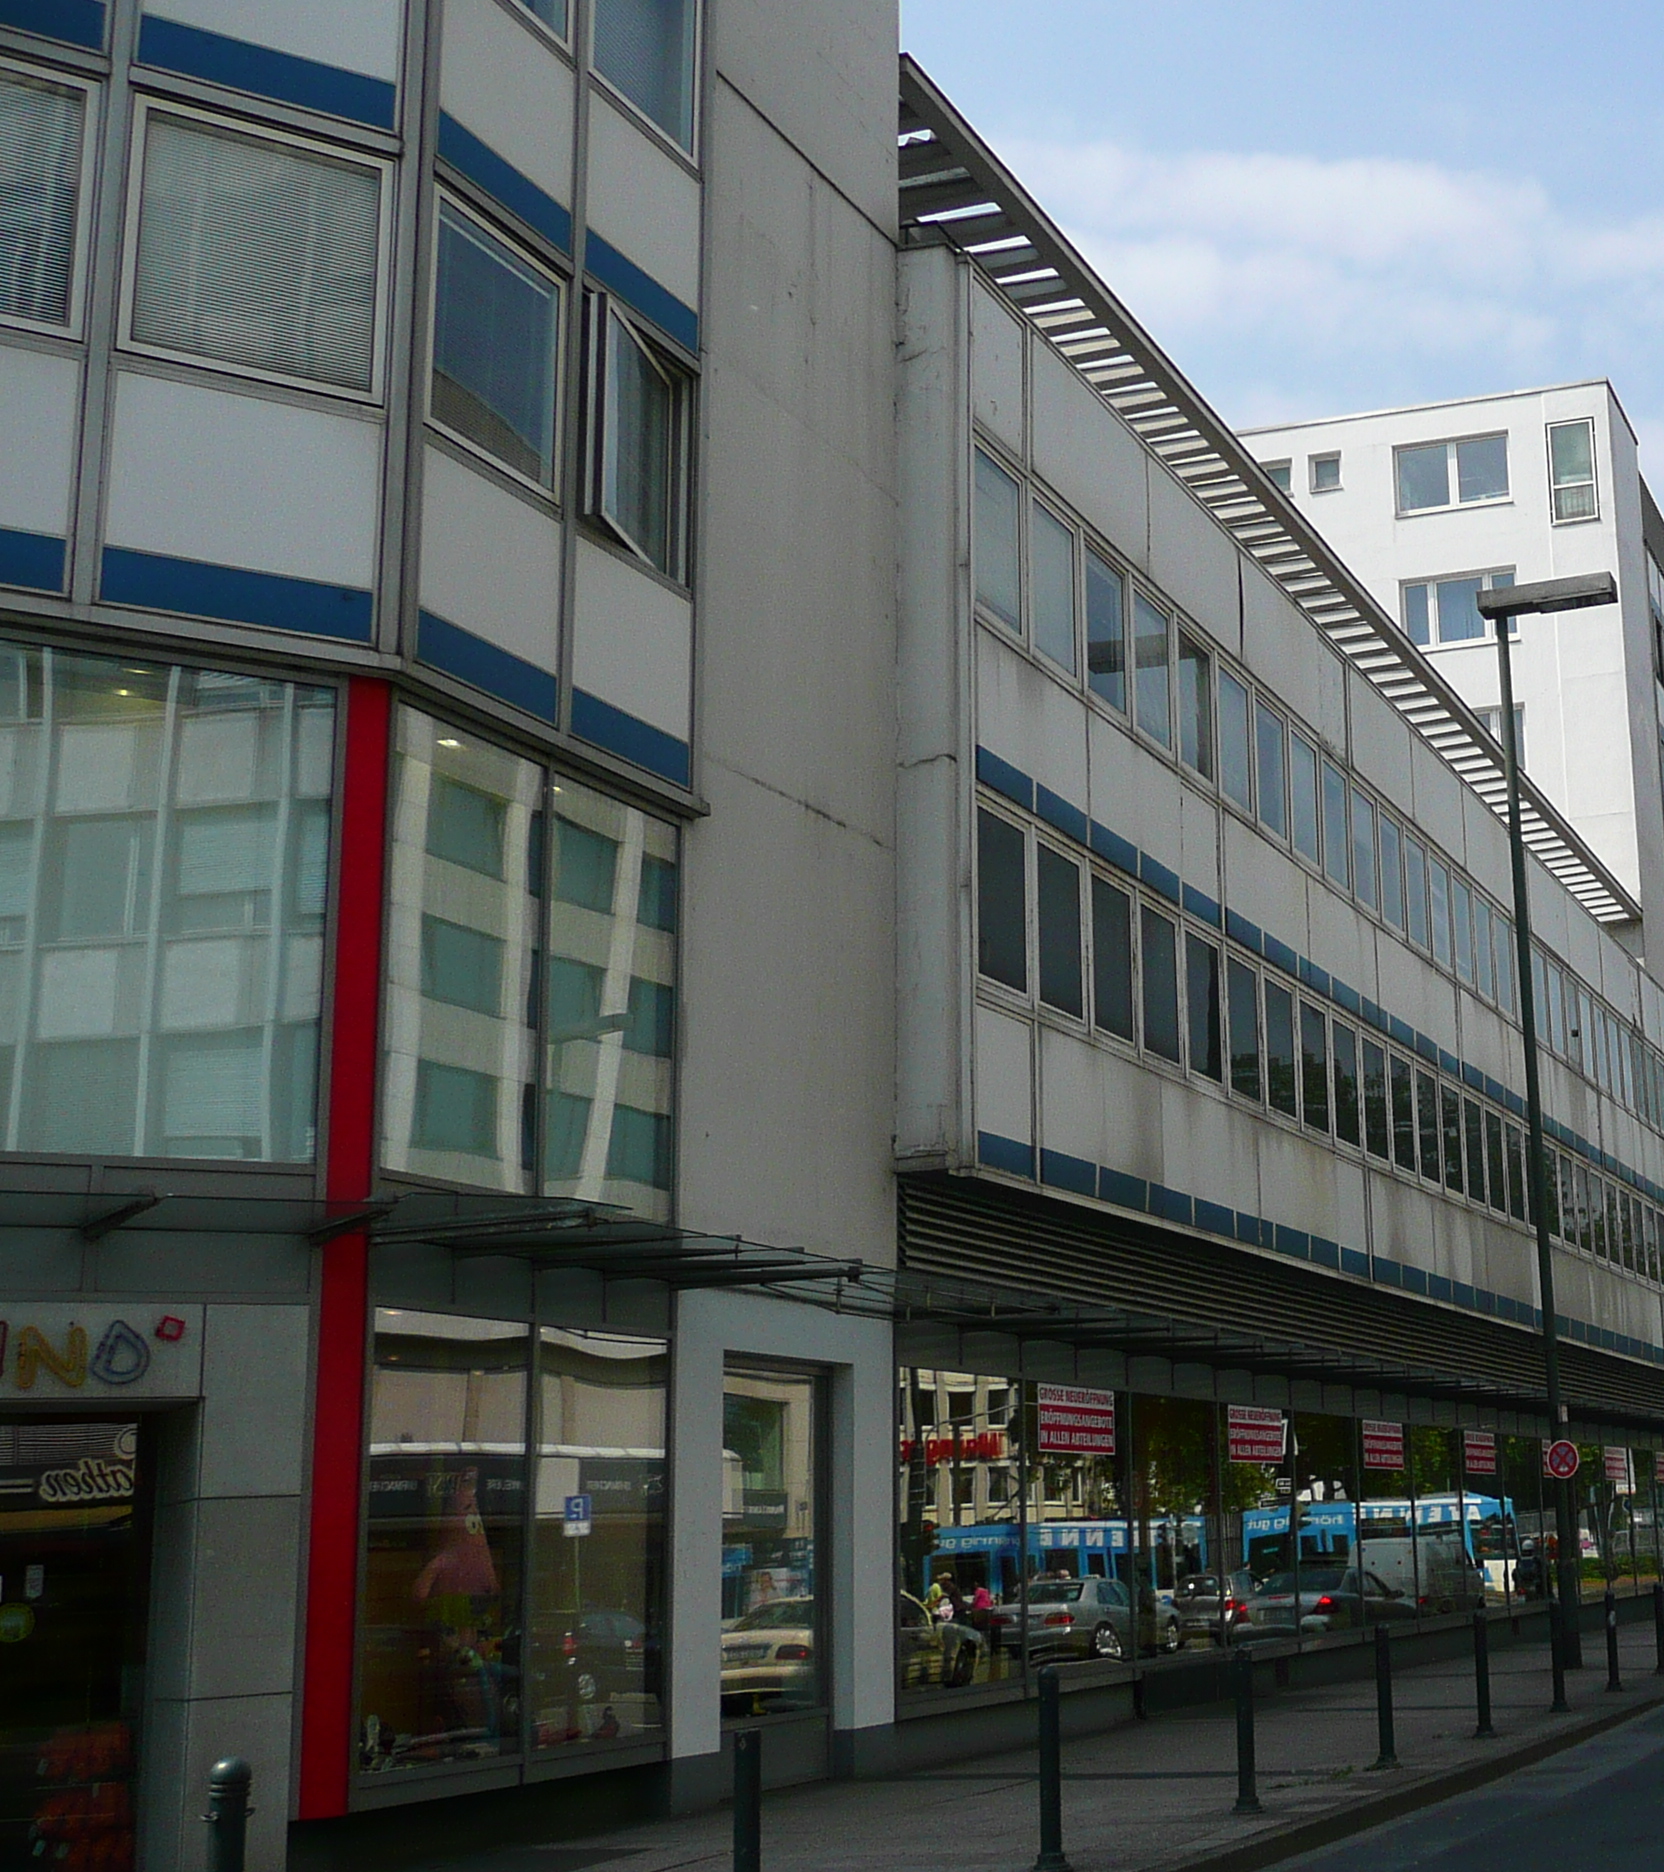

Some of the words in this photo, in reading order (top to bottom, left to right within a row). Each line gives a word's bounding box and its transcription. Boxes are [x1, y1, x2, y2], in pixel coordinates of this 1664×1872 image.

[1040, 1387, 1064, 1402] GROSSE
[1040, 1430, 1048, 1443] IN
[1049, 1430, 1070, 1445] ALLEN
[1071, 1432, 1114, 1447] ABTEILUNGEN
